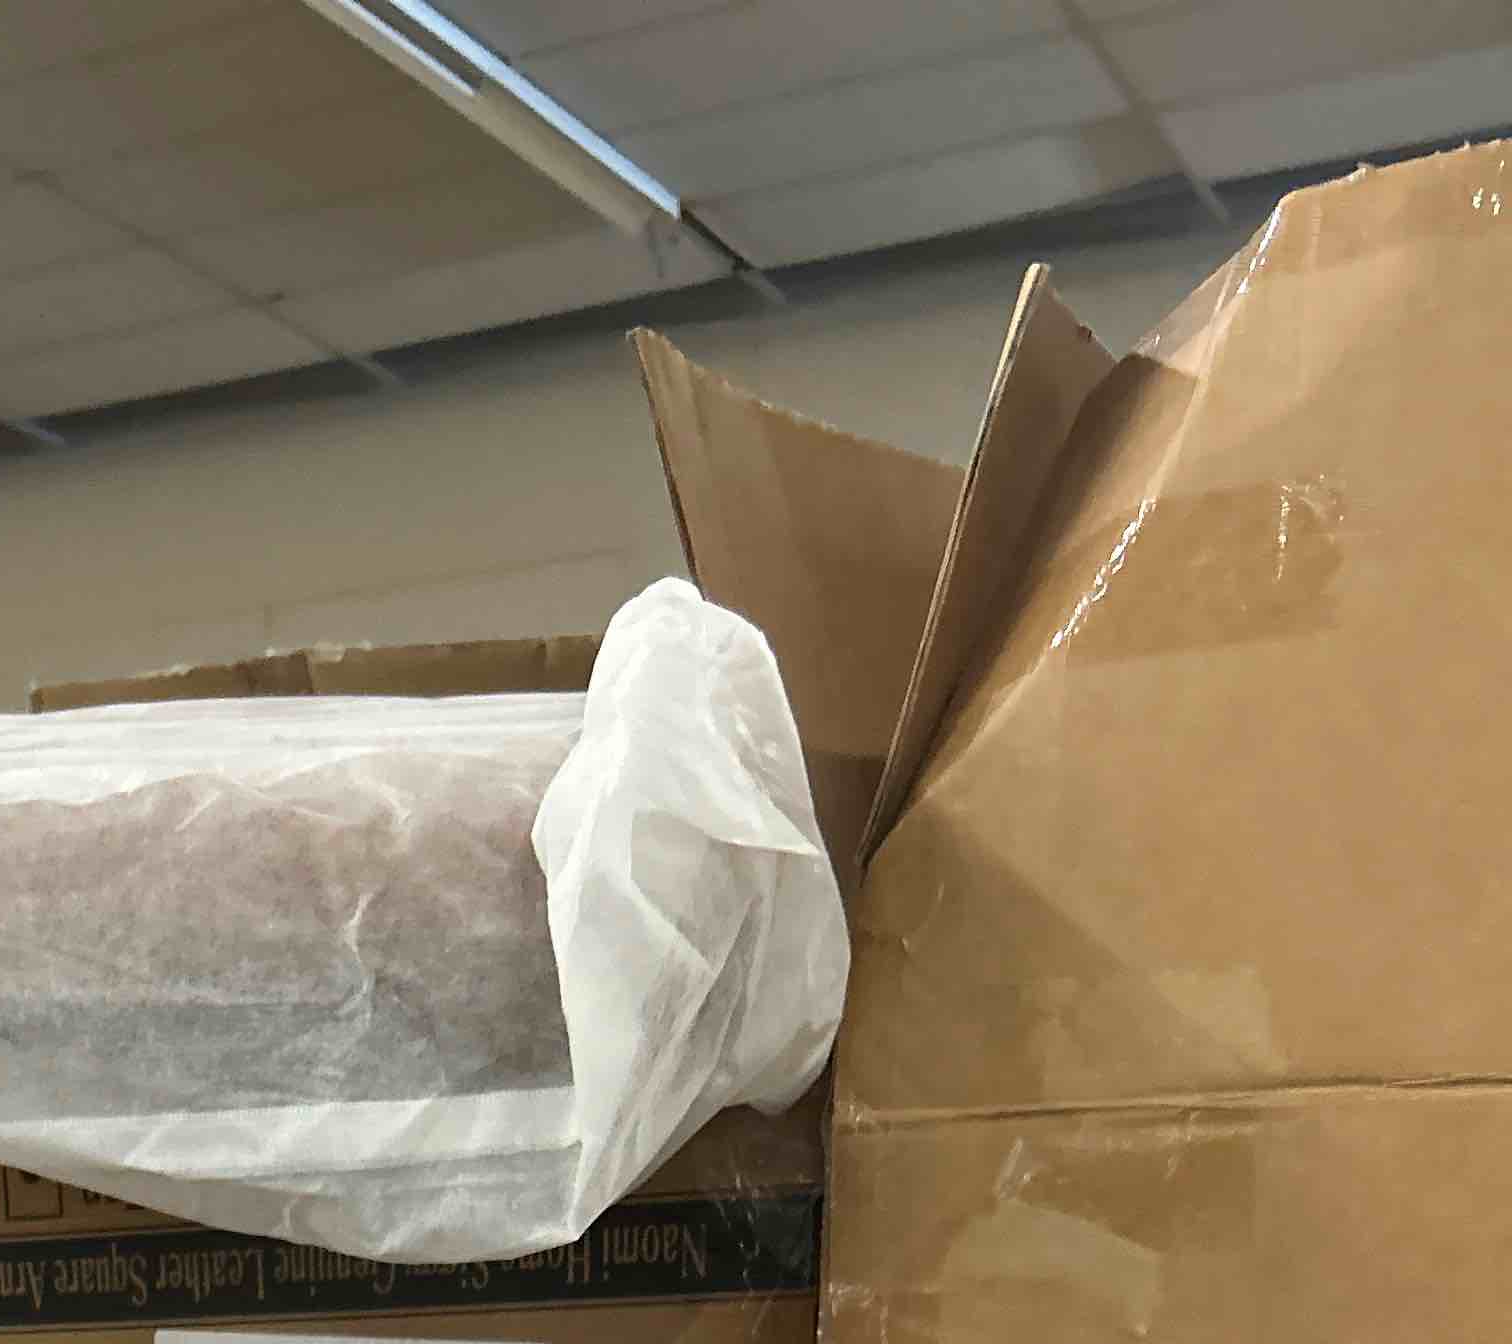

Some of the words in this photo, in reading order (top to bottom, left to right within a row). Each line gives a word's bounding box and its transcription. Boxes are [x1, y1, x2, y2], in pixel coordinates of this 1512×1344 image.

[56, 1244, 147, 1305] Square
[156, 1242, 266, 1300] Leather
[603, 1224, 710, 1281] Naomi
